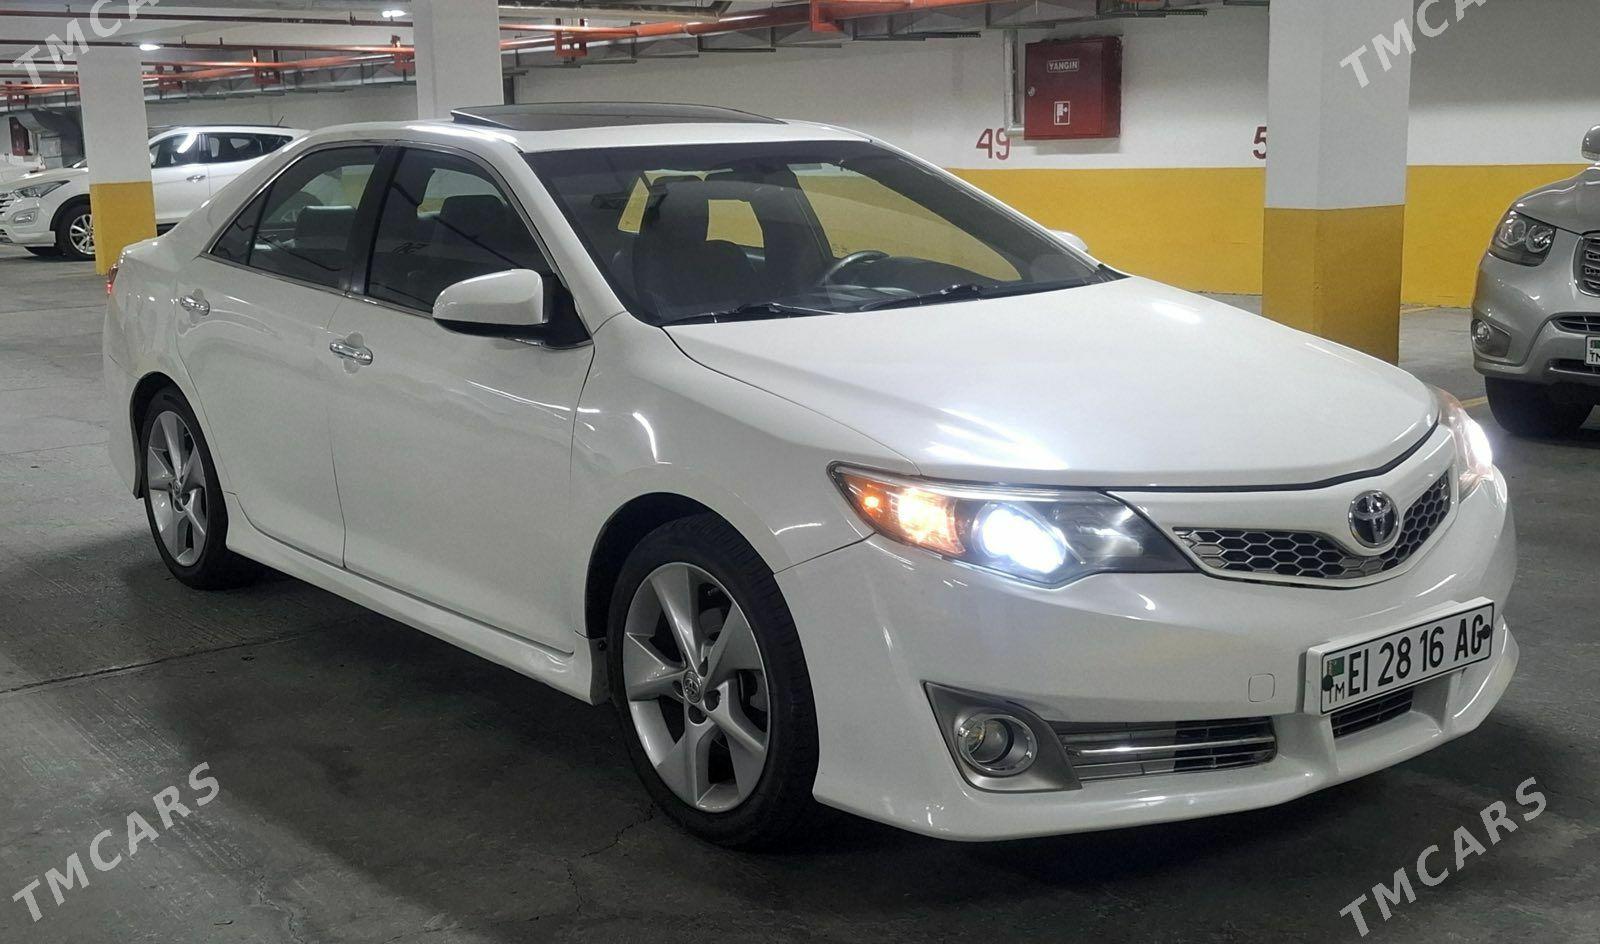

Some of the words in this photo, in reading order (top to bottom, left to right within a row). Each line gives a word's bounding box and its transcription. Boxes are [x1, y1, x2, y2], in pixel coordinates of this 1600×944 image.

[976, 127, 1010, 160] 49
[1377, 636, 1411, 687] 28
[1420, 626, 1445, 672] 16
[1454, 614, 1484, 662] AG
